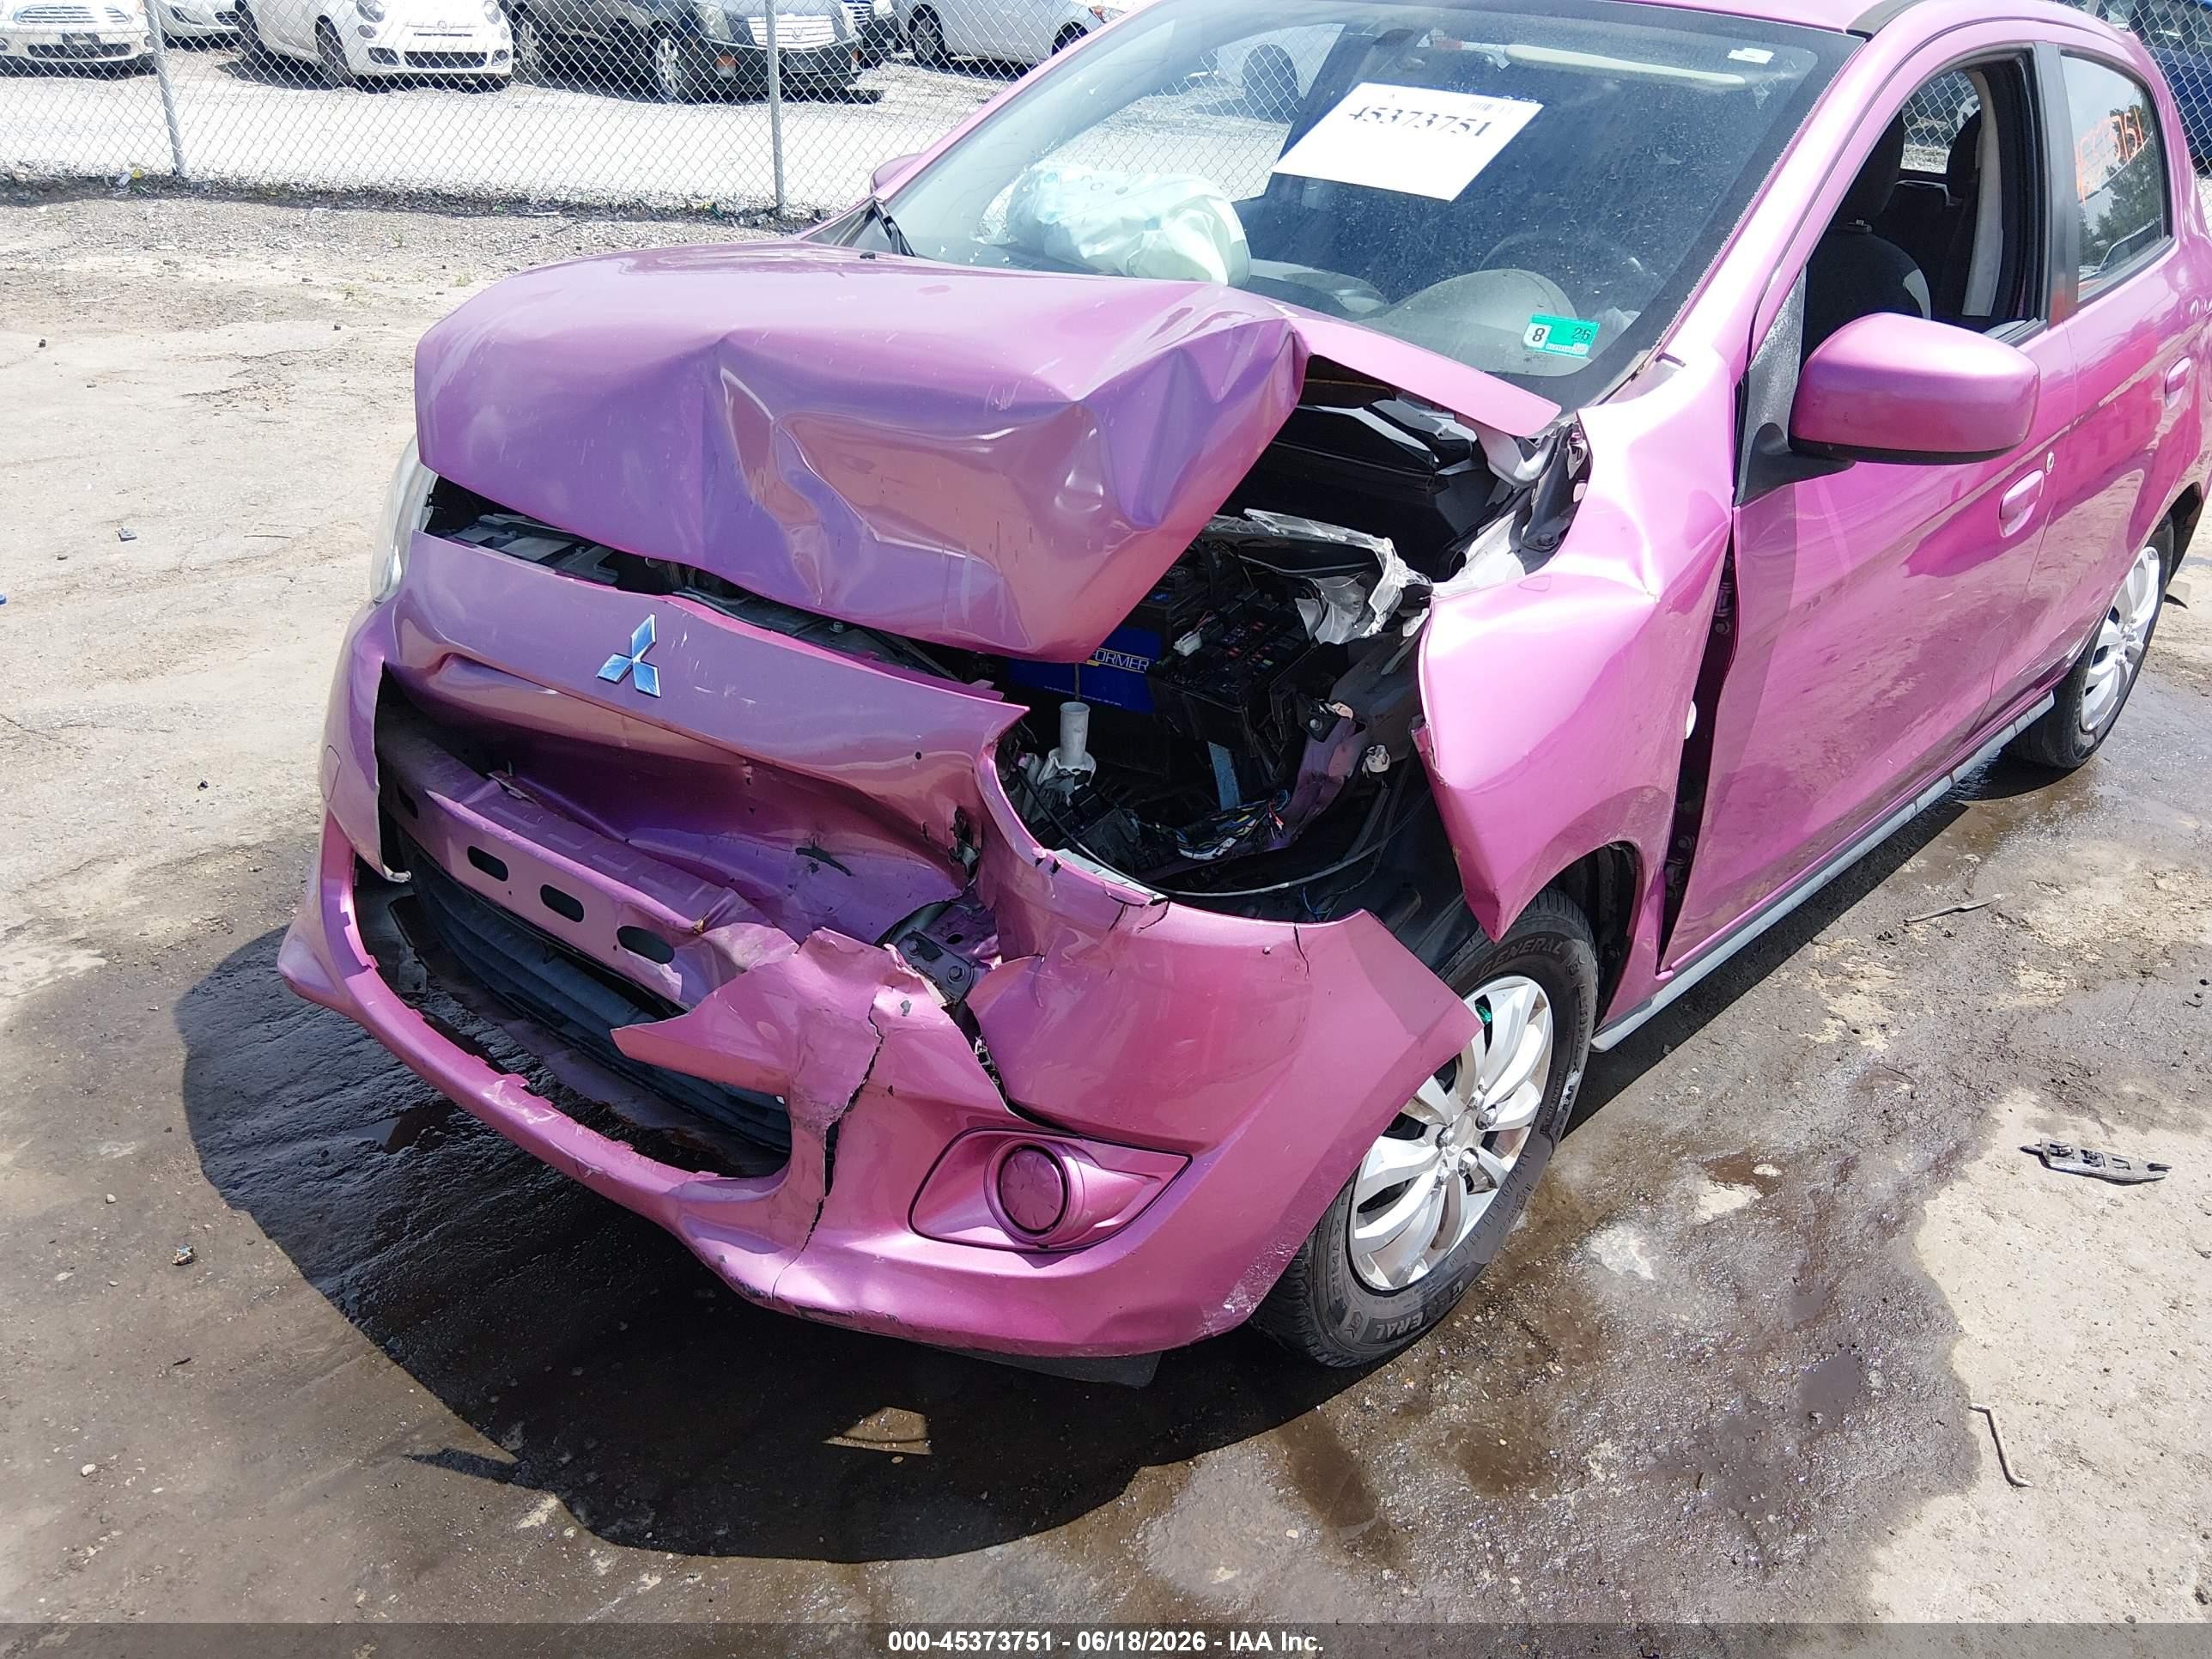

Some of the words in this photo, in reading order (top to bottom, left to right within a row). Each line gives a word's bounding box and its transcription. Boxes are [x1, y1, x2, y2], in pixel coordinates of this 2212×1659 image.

[1348, 105, 1492, 137] 45373751
[1531, 327, 1547, 343] 8
[1093, 649, 1151, 672] ORMER
